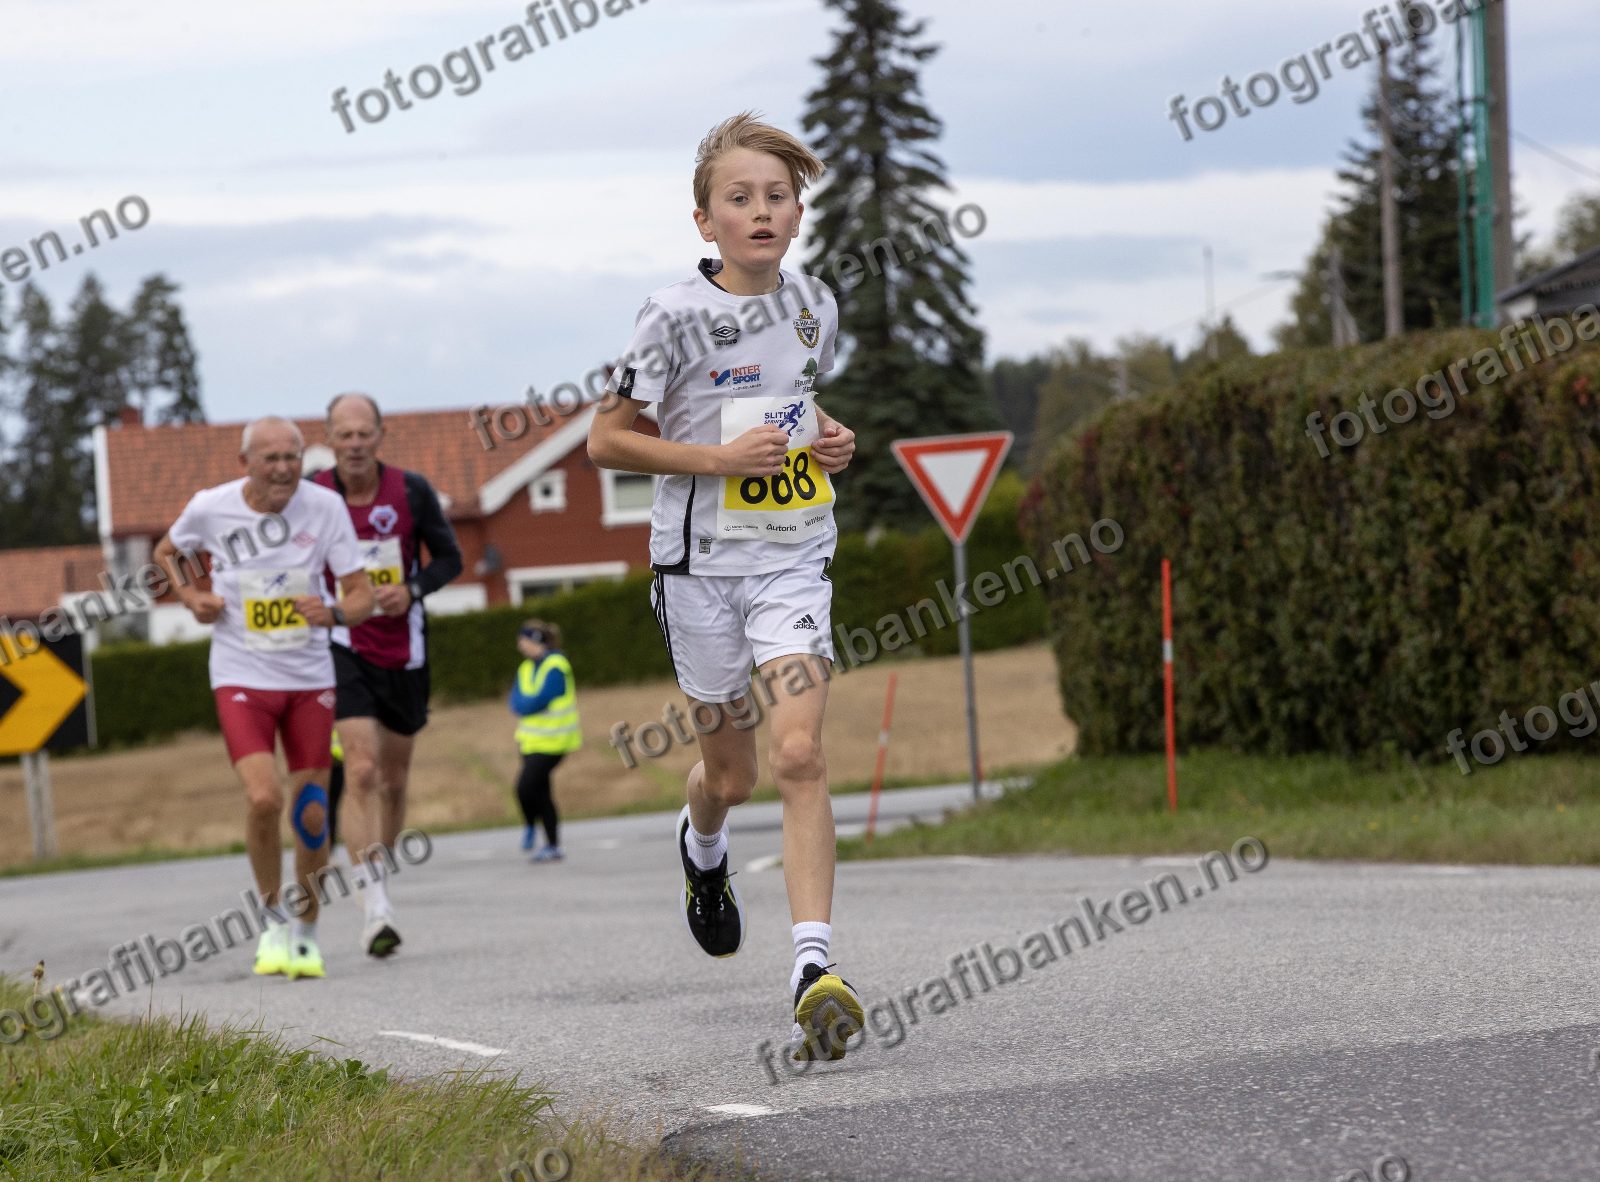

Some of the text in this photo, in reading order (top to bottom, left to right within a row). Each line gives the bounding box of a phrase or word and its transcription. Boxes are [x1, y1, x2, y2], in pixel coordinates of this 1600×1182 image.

[731, 365, 761, 377] INTER
[732, 373, 761, 385] SPORT
[766, 523, 797, 532] Autoria
[253, 598, 299, 628] 802
[793, 623, 818, 631] adidas
